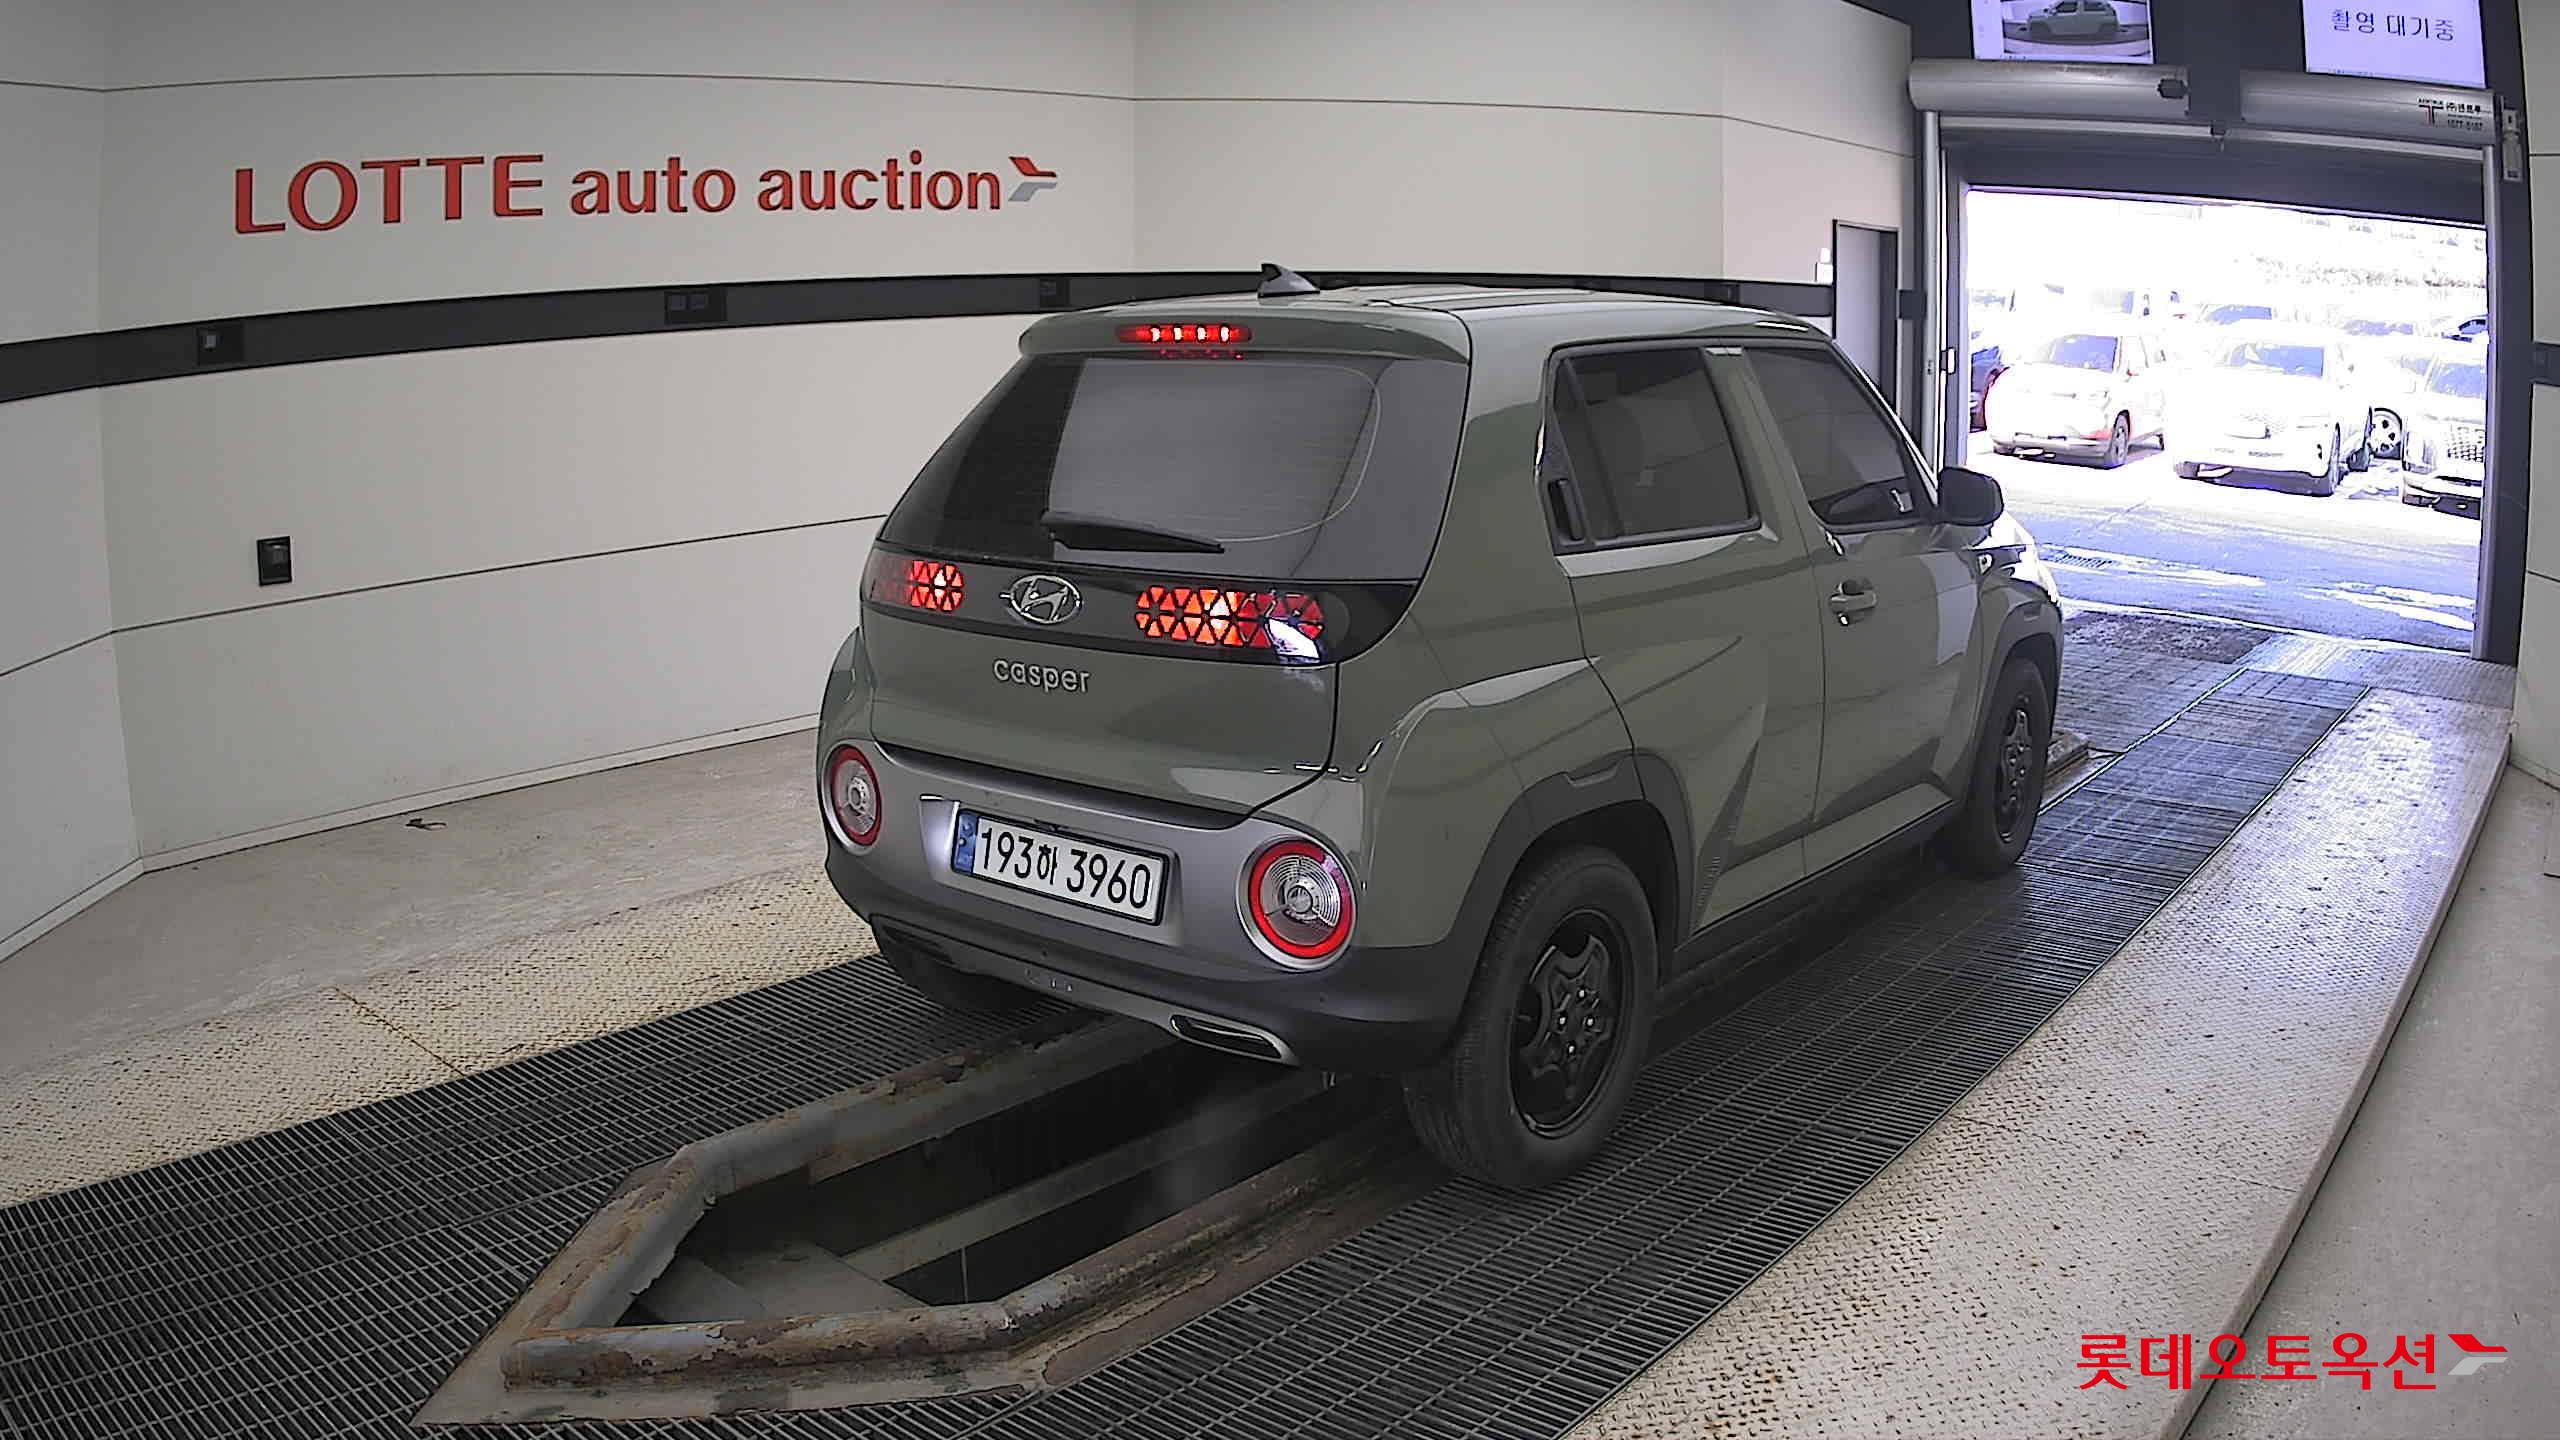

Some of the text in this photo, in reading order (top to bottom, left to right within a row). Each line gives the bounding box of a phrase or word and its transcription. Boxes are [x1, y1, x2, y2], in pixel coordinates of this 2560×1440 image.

[2331, 9, 2454, 41] 촬영 대기중
[235, 150, 1001, 235] LOTTE auto auction
[993, 658, 1090, 693] casper
[981, 827, 1151, 909] 193하 3960
